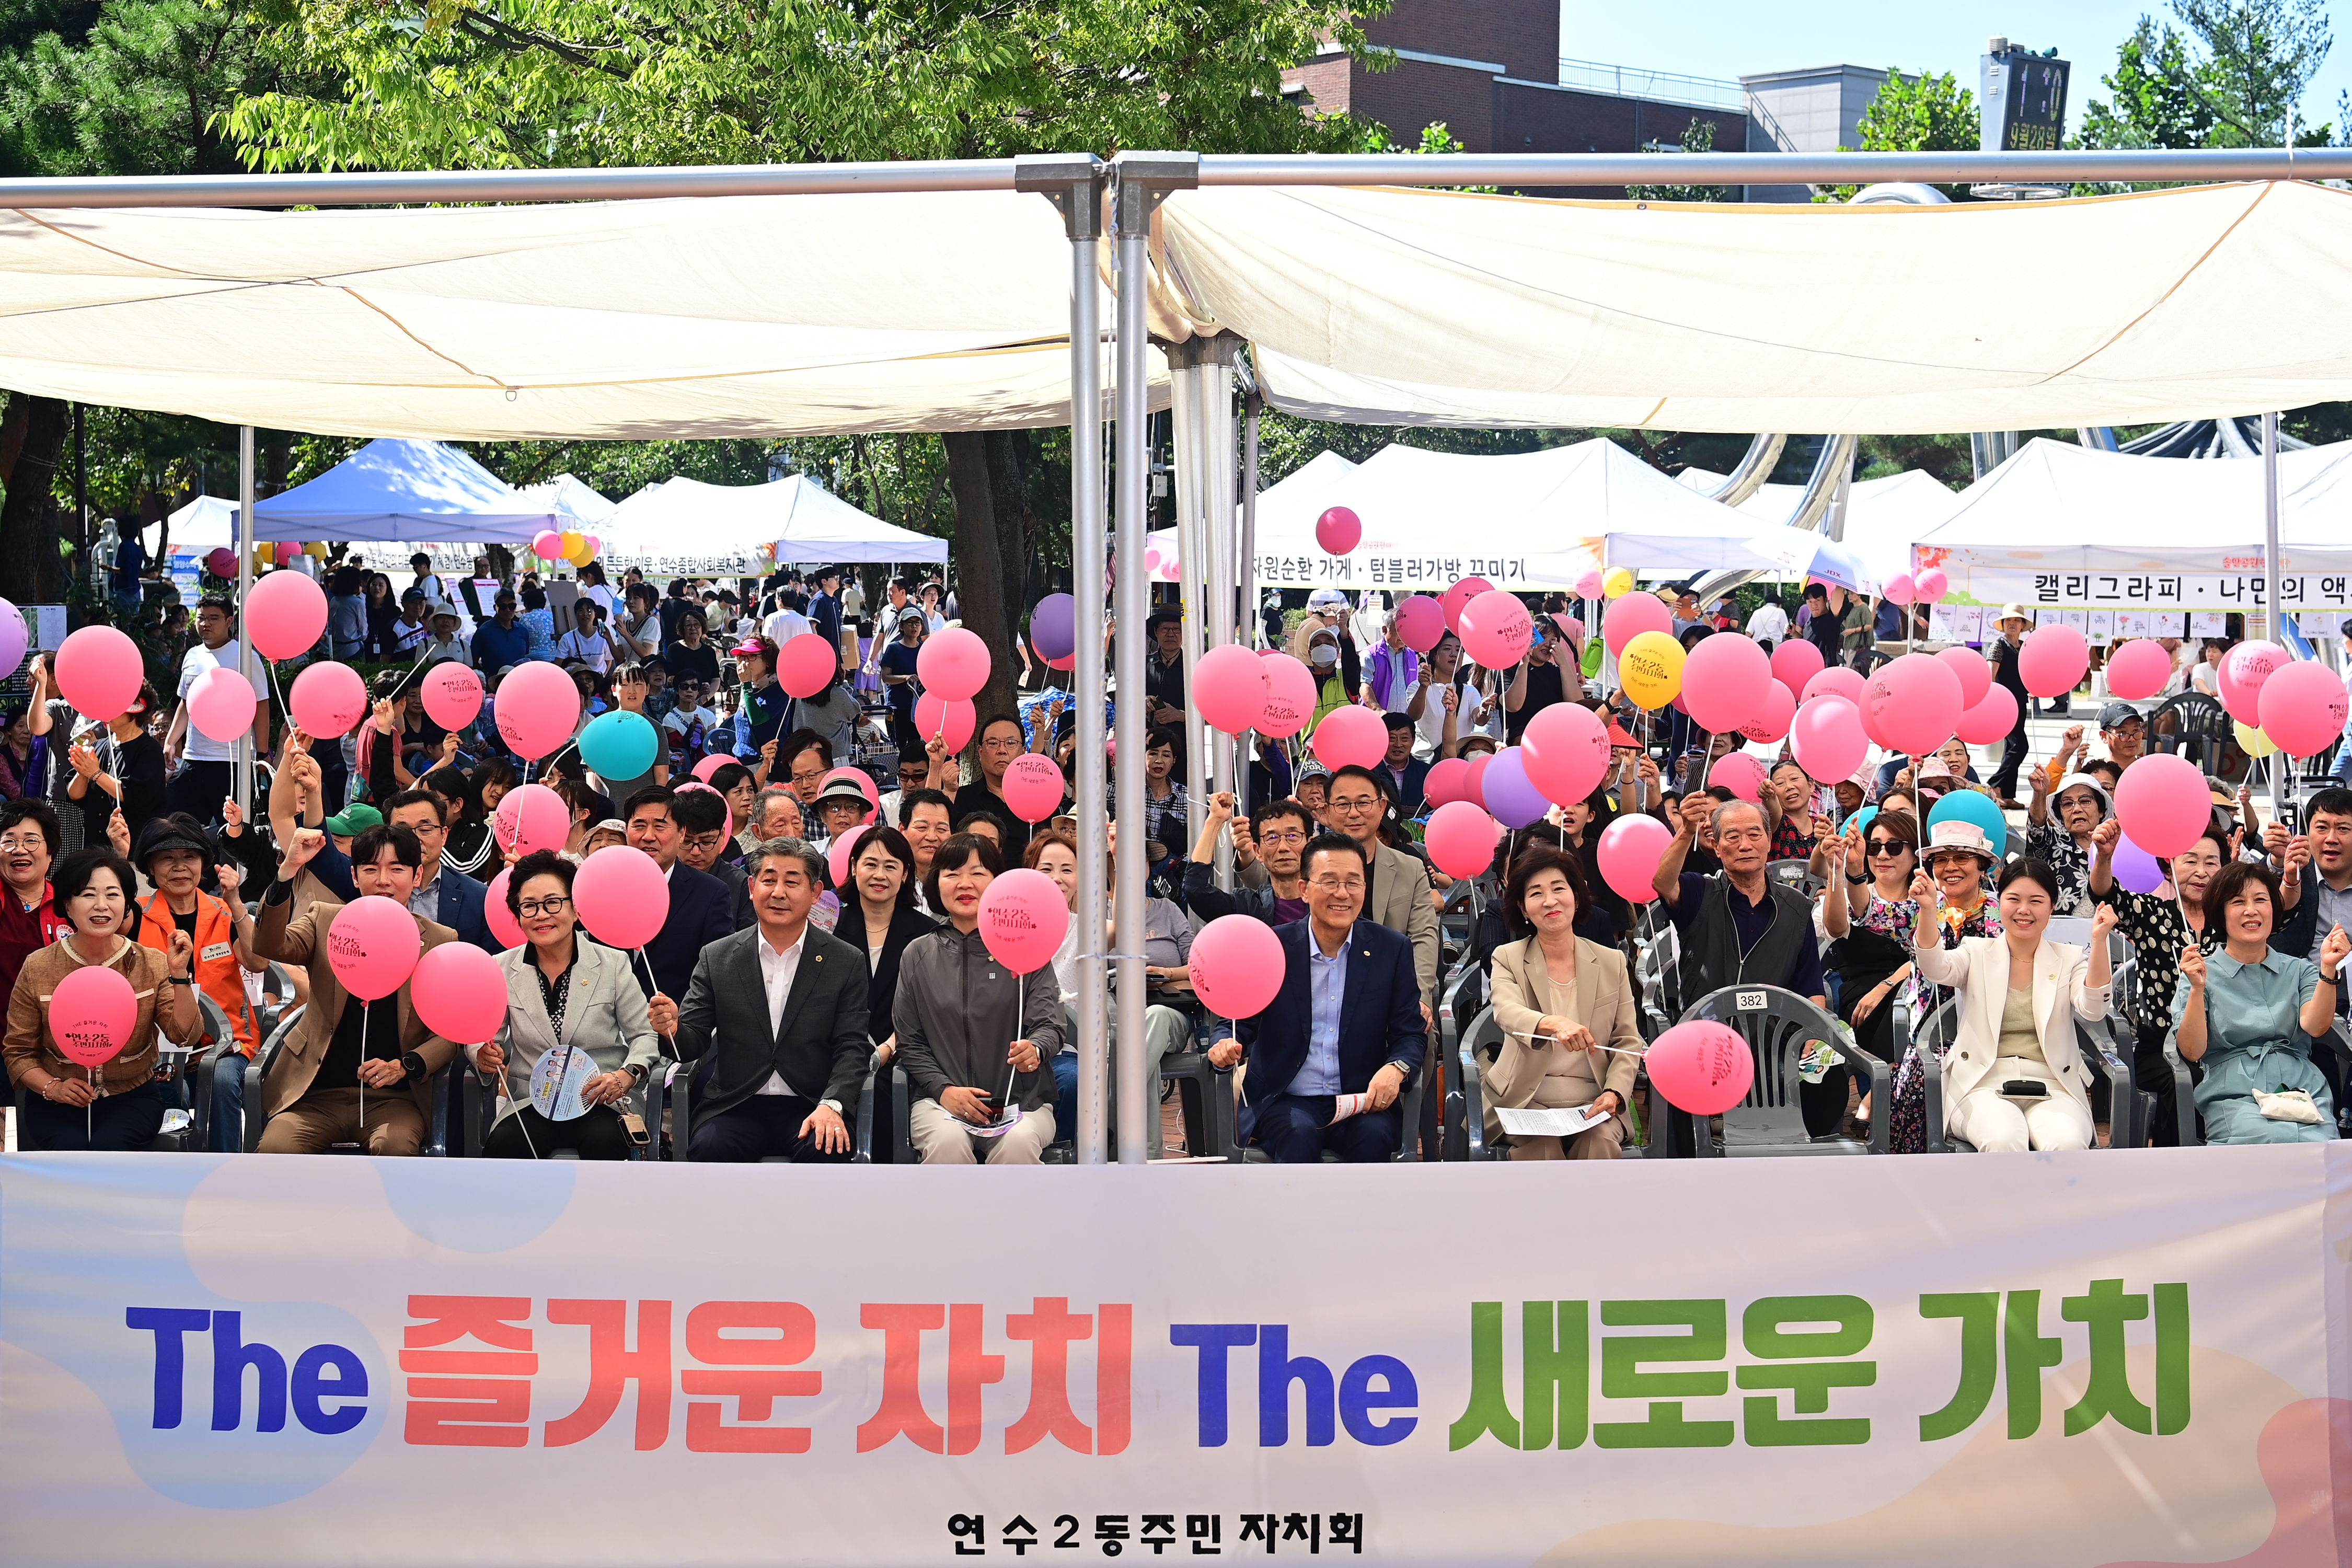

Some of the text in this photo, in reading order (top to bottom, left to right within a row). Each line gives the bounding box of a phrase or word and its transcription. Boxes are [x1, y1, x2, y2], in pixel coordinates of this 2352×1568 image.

[660, 557, 746, 574] 연수종합사회복지관
[1319, 558, 1351, 580] 가게
[1370, 558, 1461, 583] 텀블러가방
[1469, 558, 1525, 582] 꾸미기
[1824, 569, 1841, 578] JDX
[2035, 575, 2181, 602] 캘리그라피
[2321, 577, 2352, 604] 액
[1633, 654, 1665, 673] 연수2동
[1630, 664, 1664, 679] 주민자치회
[1304, 764, 1327, 774] YORK
[993, 907, 1031, 920] 연수2동
[991, 918, 1031, 929] 주민자치회
[331, 933, 361, 949] 연수2동
[1740, 995, 1762, 1007] 382
[71, 1032, 110, 1043] 연수2동
[126, 1278, 2190, 1456] The 즐거운 자치 The 새로운 가치
[1239, 1513, 1363, 1554] 자치회
